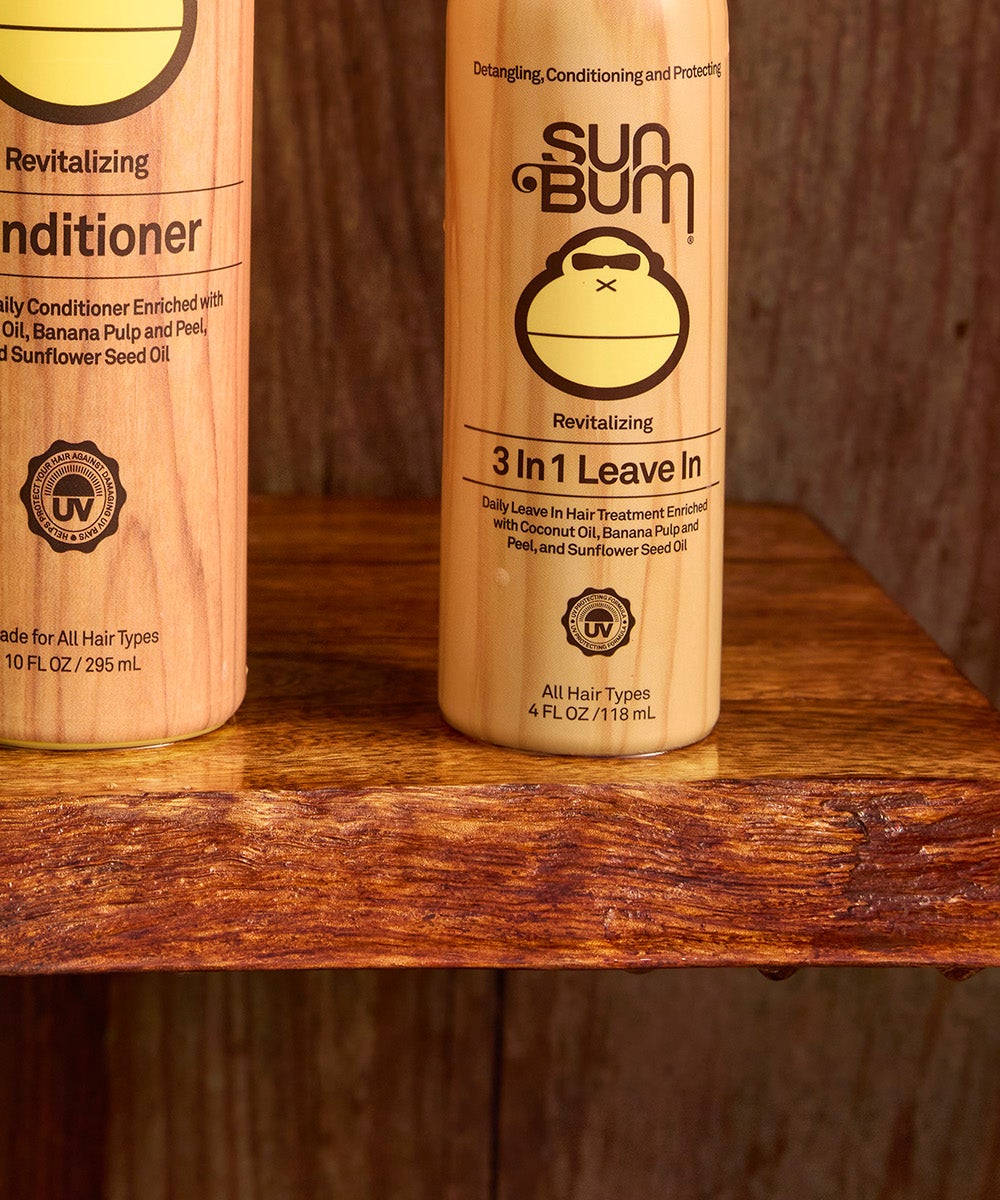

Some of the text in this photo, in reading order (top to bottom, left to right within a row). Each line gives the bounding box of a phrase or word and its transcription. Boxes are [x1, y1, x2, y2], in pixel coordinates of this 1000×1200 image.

[474, 61, 721, 86] Detangling, Conditioning and Protecting
[6, 147, 149, 179] Revitalizing
[27, 299, 130, 317] Conditioner
[133, 294, 197, 315] Enriched
[200, 290, 223, 308] with
[2, 320, 30, 342] Oil,
[33, 323, 100, 341] Banana
[104, 323, 141, 344] Pulp
[145, 321, 173, 339] and
[176, 317, 207, 336] Peel,
[11, 346, 102, 365] Sunflower
[105, 348, 146, 365] Seed
[150, 345, 170, 363] Oil
[553, 413, 653, 433] Revitalizing
[493, 446, 701, 485] 3 In 1 Leave In
[33, 453, 114, 540] HELPS PROTECT YOUR HAIR AGAINST DAMAGING UV RAYS
[482, 496, 708, 521] Daily Leave In Hair Treatment Enriched
[53, 498, 95, 522] UV
[493, 517, 699, 541] with Coconut Oil, Banana Pulp and
[507, 537, 687, 557] Peel, and Sunflower Seed Oil
[32, 629, 54, 645] for
[57, 630, 78, 646] All
[83, 631, 115, 646] Hair
[117, 629, 159, 648] Types
[584, 623, 613, 638] UV
[6, 654, 23, 670] 10
[28, 656, 47, 671] FL
[50, 657, 72, 672] OZ
[85, 657, 114, 672] 295
[118, 656, 141, 671] mL
[542, 685, 650, 704] All Hair Types
[528, 703, 539, 718] 4
[543, 704, 562, 720] FL
[566, 706, 588, 720] OZ
[633, 706, 656, 720] mL
